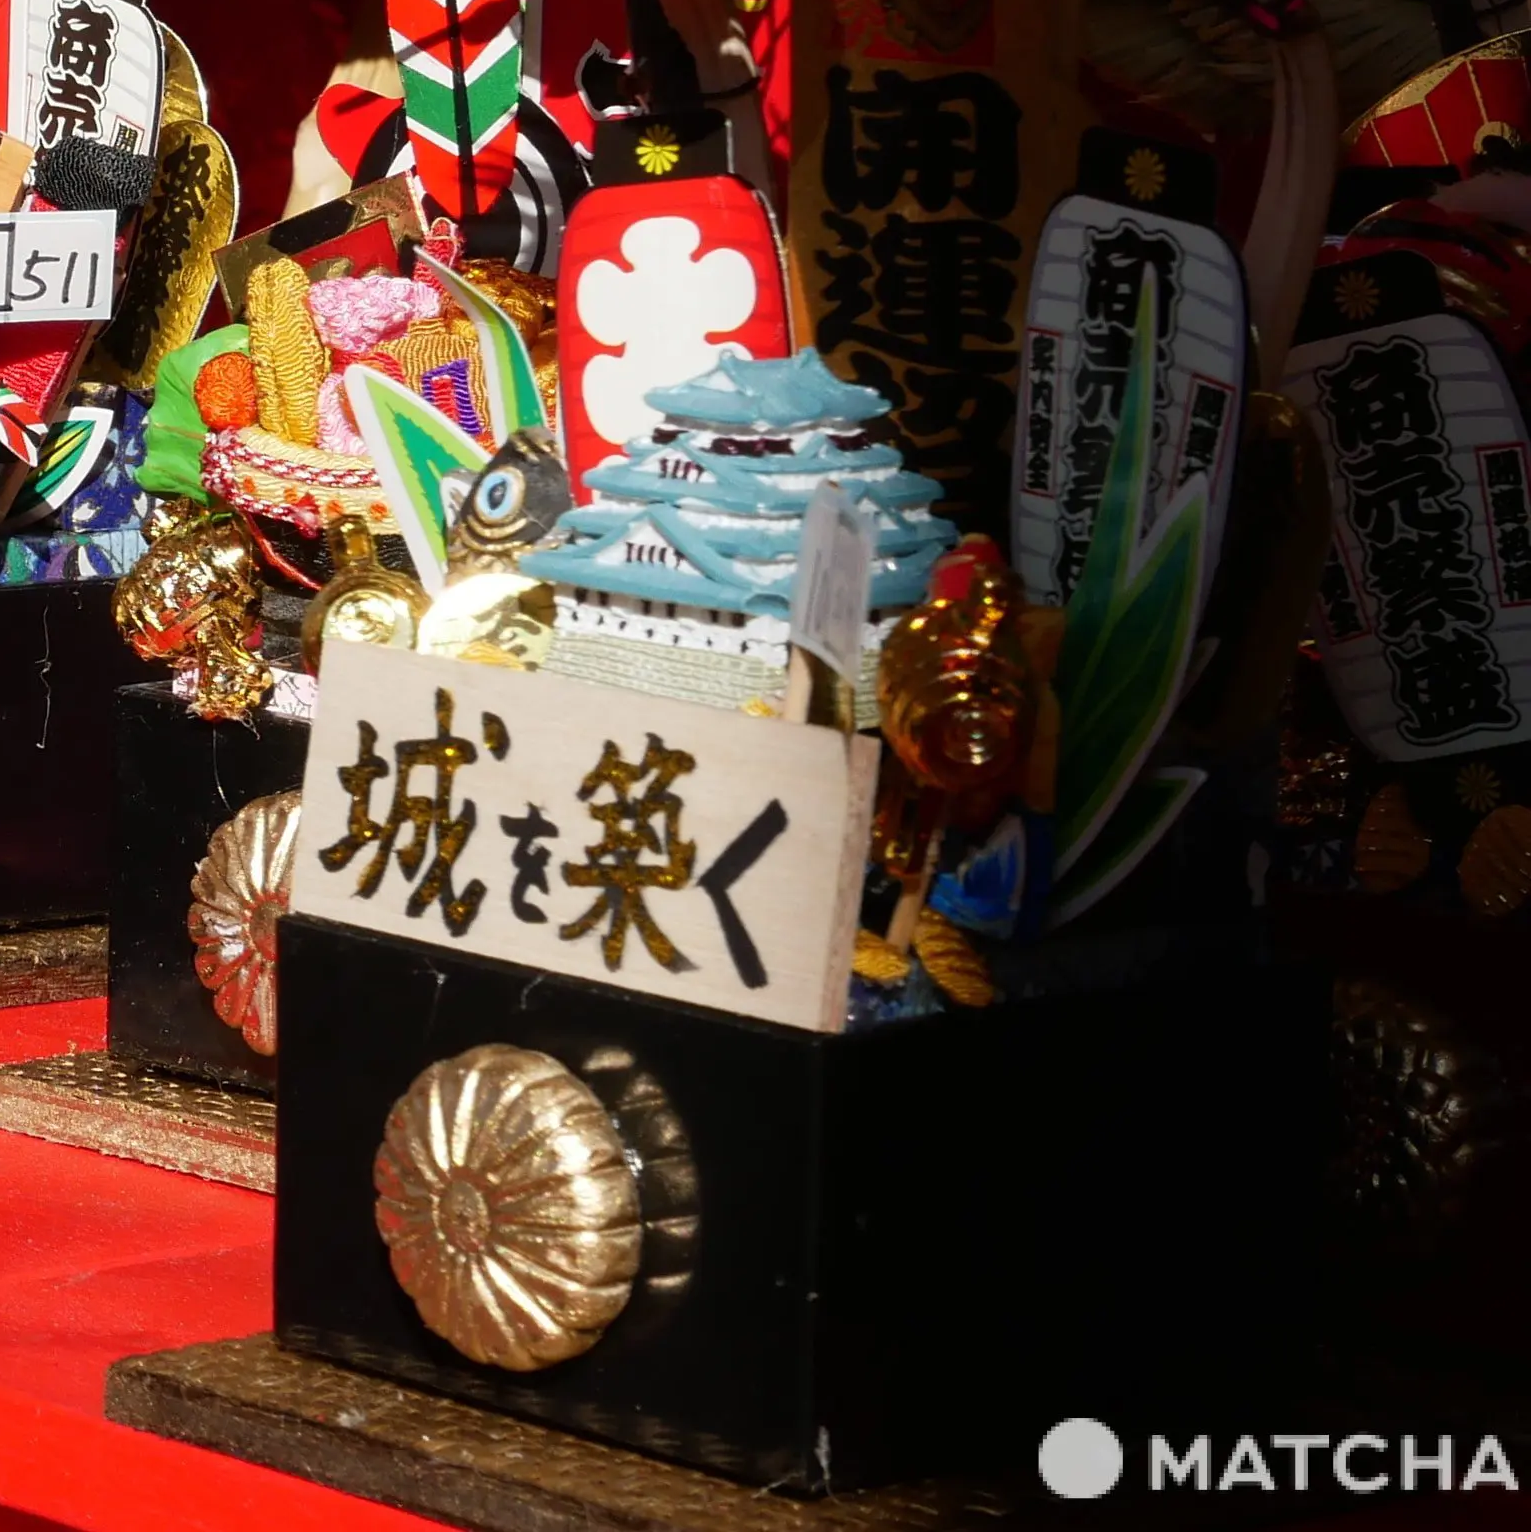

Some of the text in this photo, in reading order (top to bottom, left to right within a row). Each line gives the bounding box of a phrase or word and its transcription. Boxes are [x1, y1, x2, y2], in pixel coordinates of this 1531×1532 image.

[9, 251, 101, 309] 511
[317, 686, 788, 990] 城を築く
